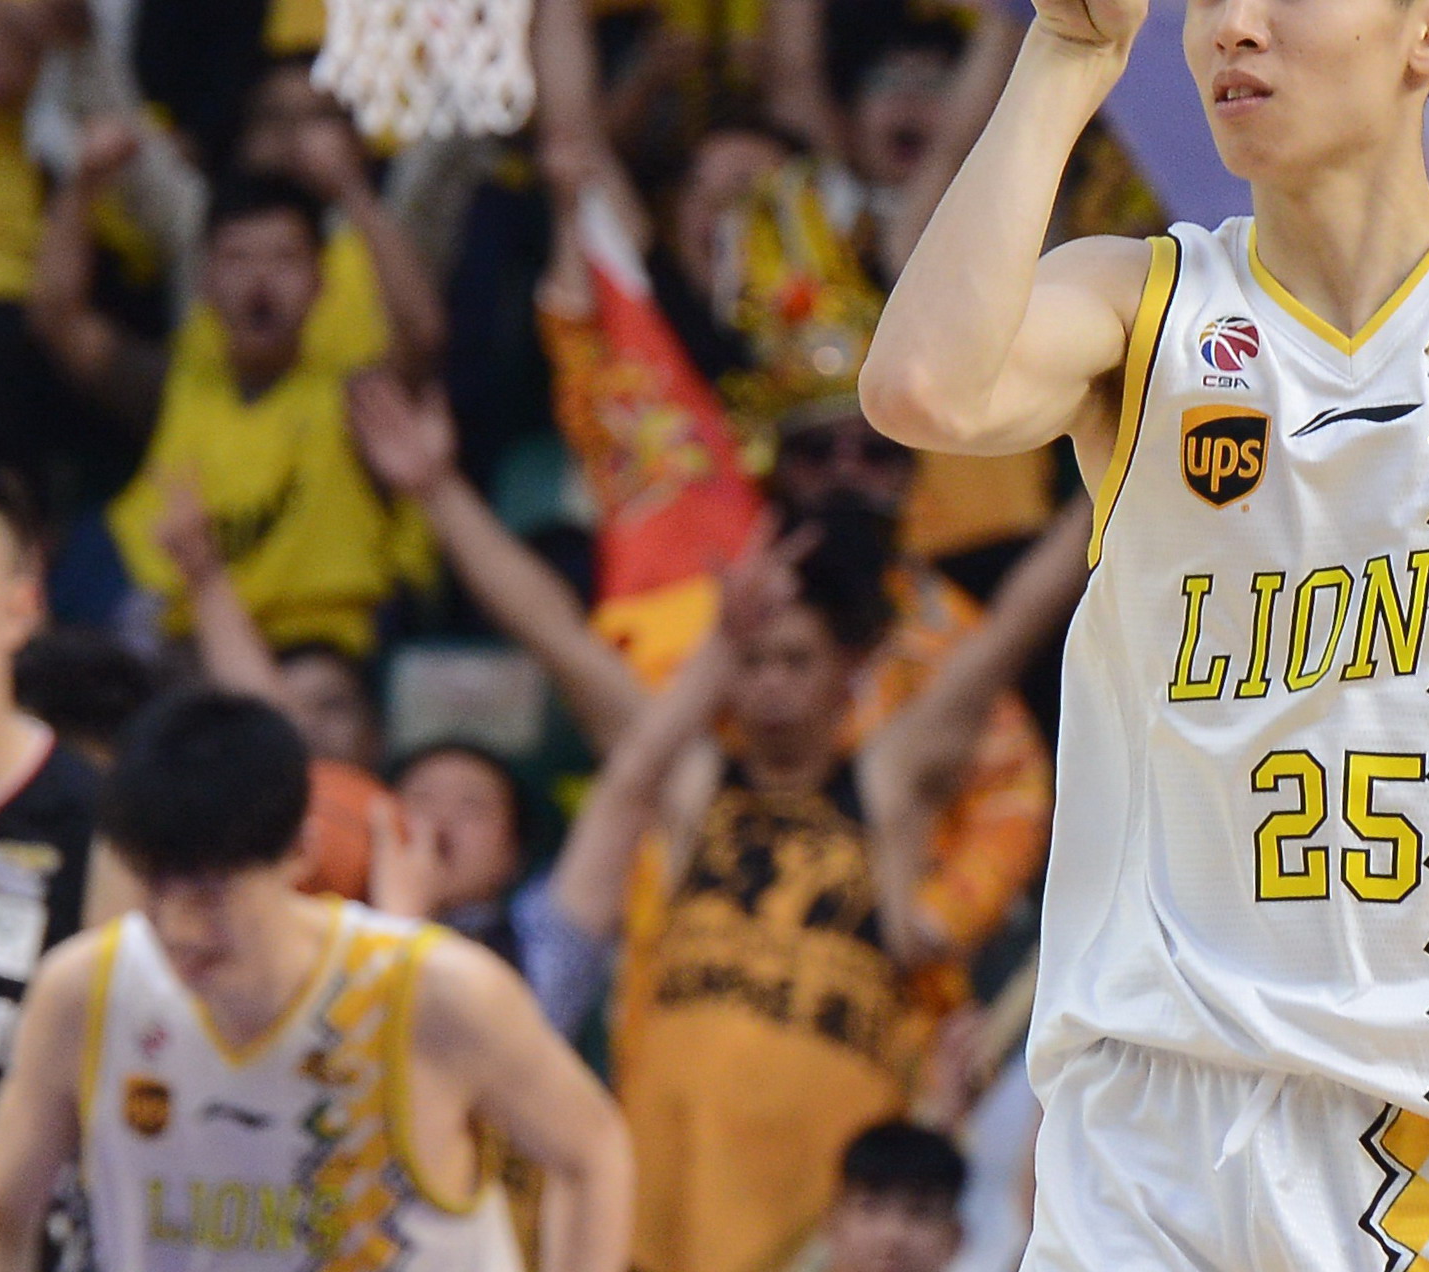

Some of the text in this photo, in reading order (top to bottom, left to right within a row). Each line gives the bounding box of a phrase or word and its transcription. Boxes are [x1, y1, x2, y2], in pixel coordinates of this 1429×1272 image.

[1202, 375, 1250, 390] CBA
[1185, 436, 1262, 494] ups
[1250, 747, 1428, 903] 25
[146, 1178, 351, 1258] LIONS
